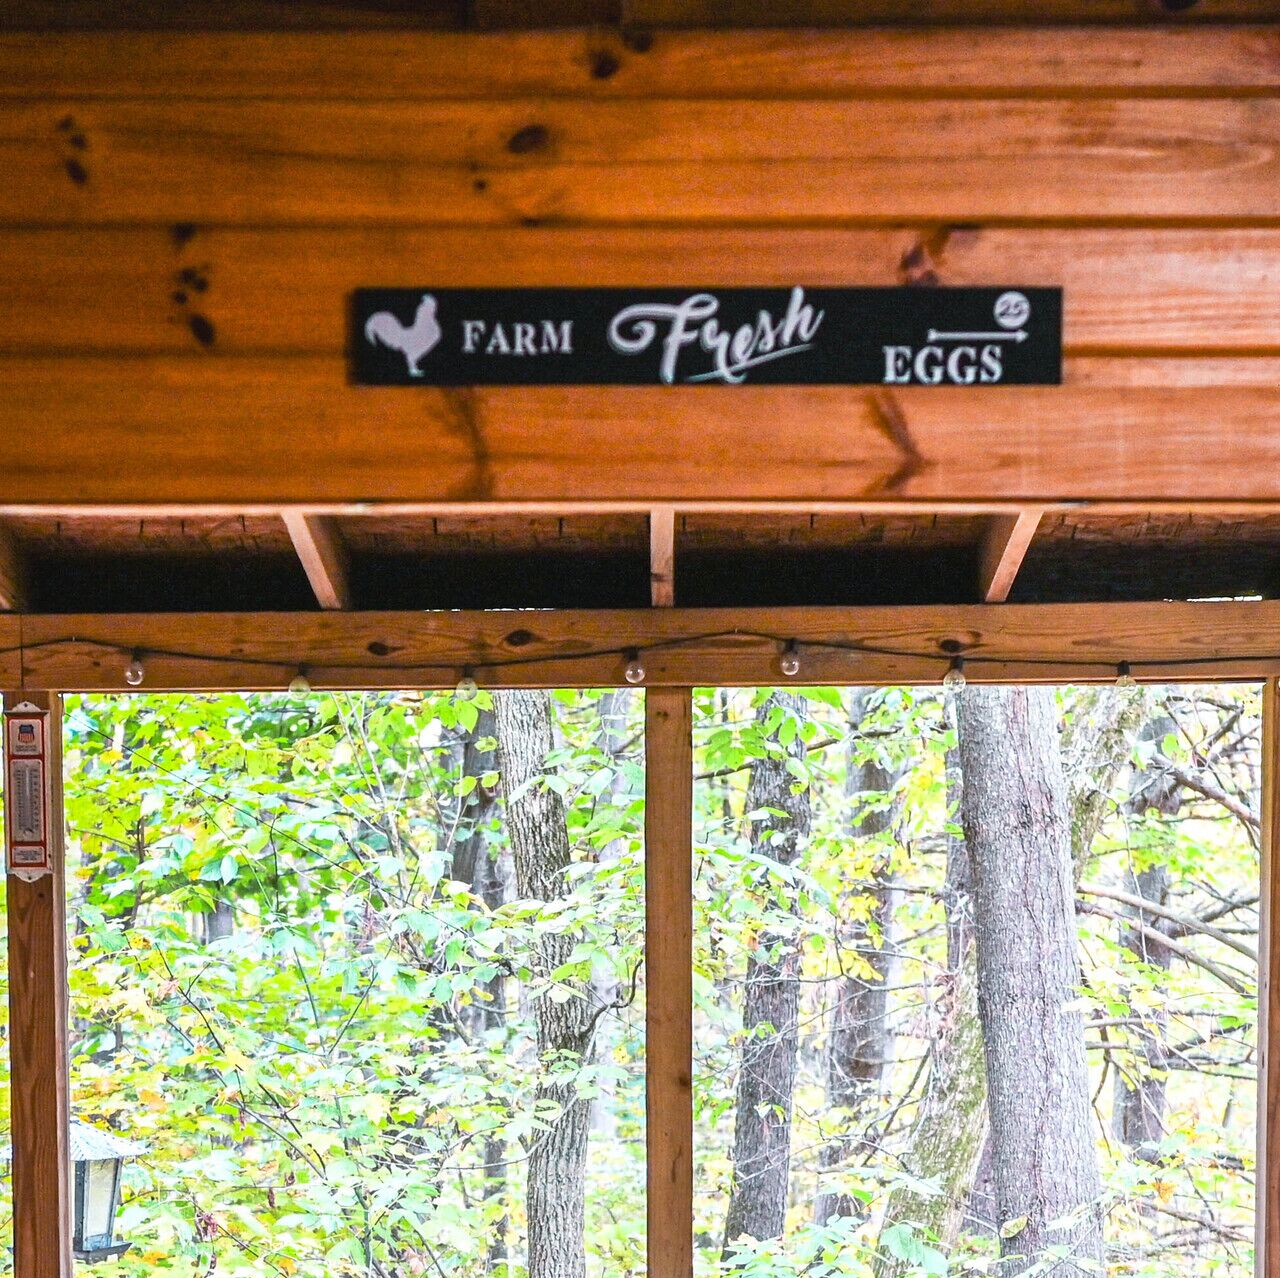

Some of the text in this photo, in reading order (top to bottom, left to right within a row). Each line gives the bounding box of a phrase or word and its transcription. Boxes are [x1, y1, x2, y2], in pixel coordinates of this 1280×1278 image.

[463, 286, 1004, 385] FARM Fresh EGGS
